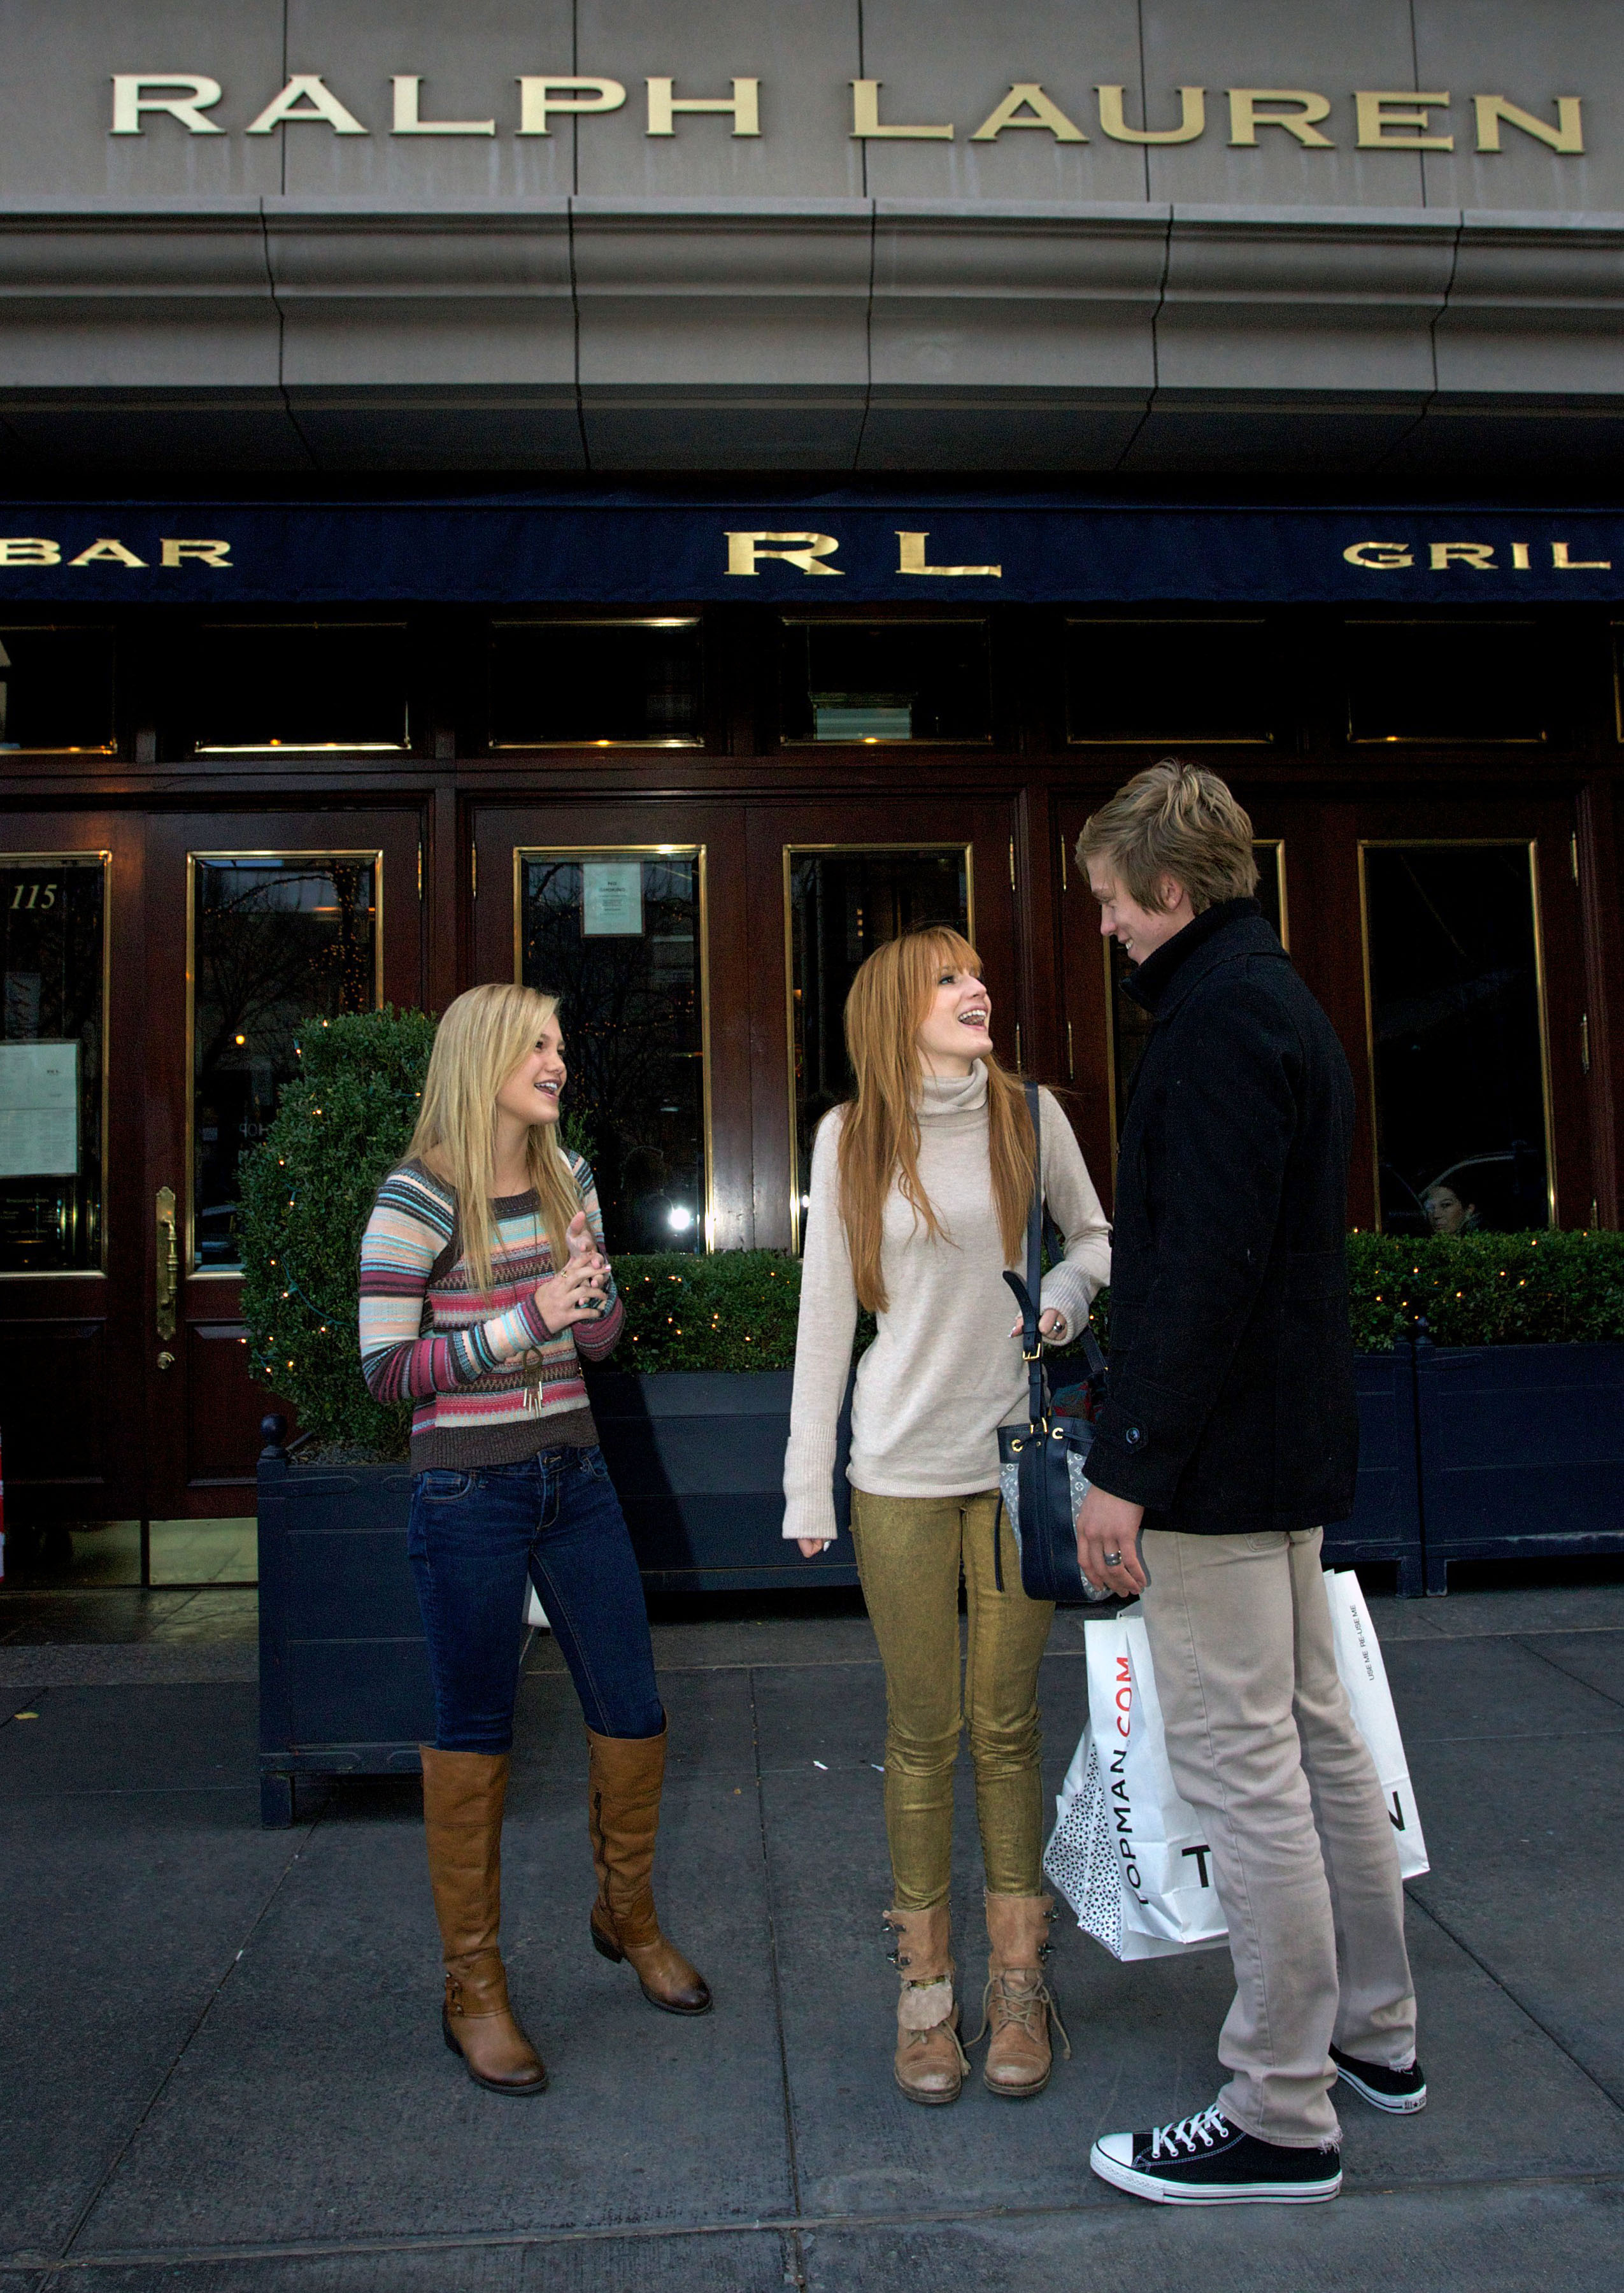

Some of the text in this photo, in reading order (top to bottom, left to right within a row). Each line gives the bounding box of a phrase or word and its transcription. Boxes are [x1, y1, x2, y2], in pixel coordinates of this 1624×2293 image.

[110, 75, 1586, 155] RALPH LAUREN
[0, 538, 233, 568] BAR
[1343, 541, 1611, 570] GRIL
[10, 884, 57, 910] 115
[1350, 1604, 1375, 1681] USE ME RE-USE ME
